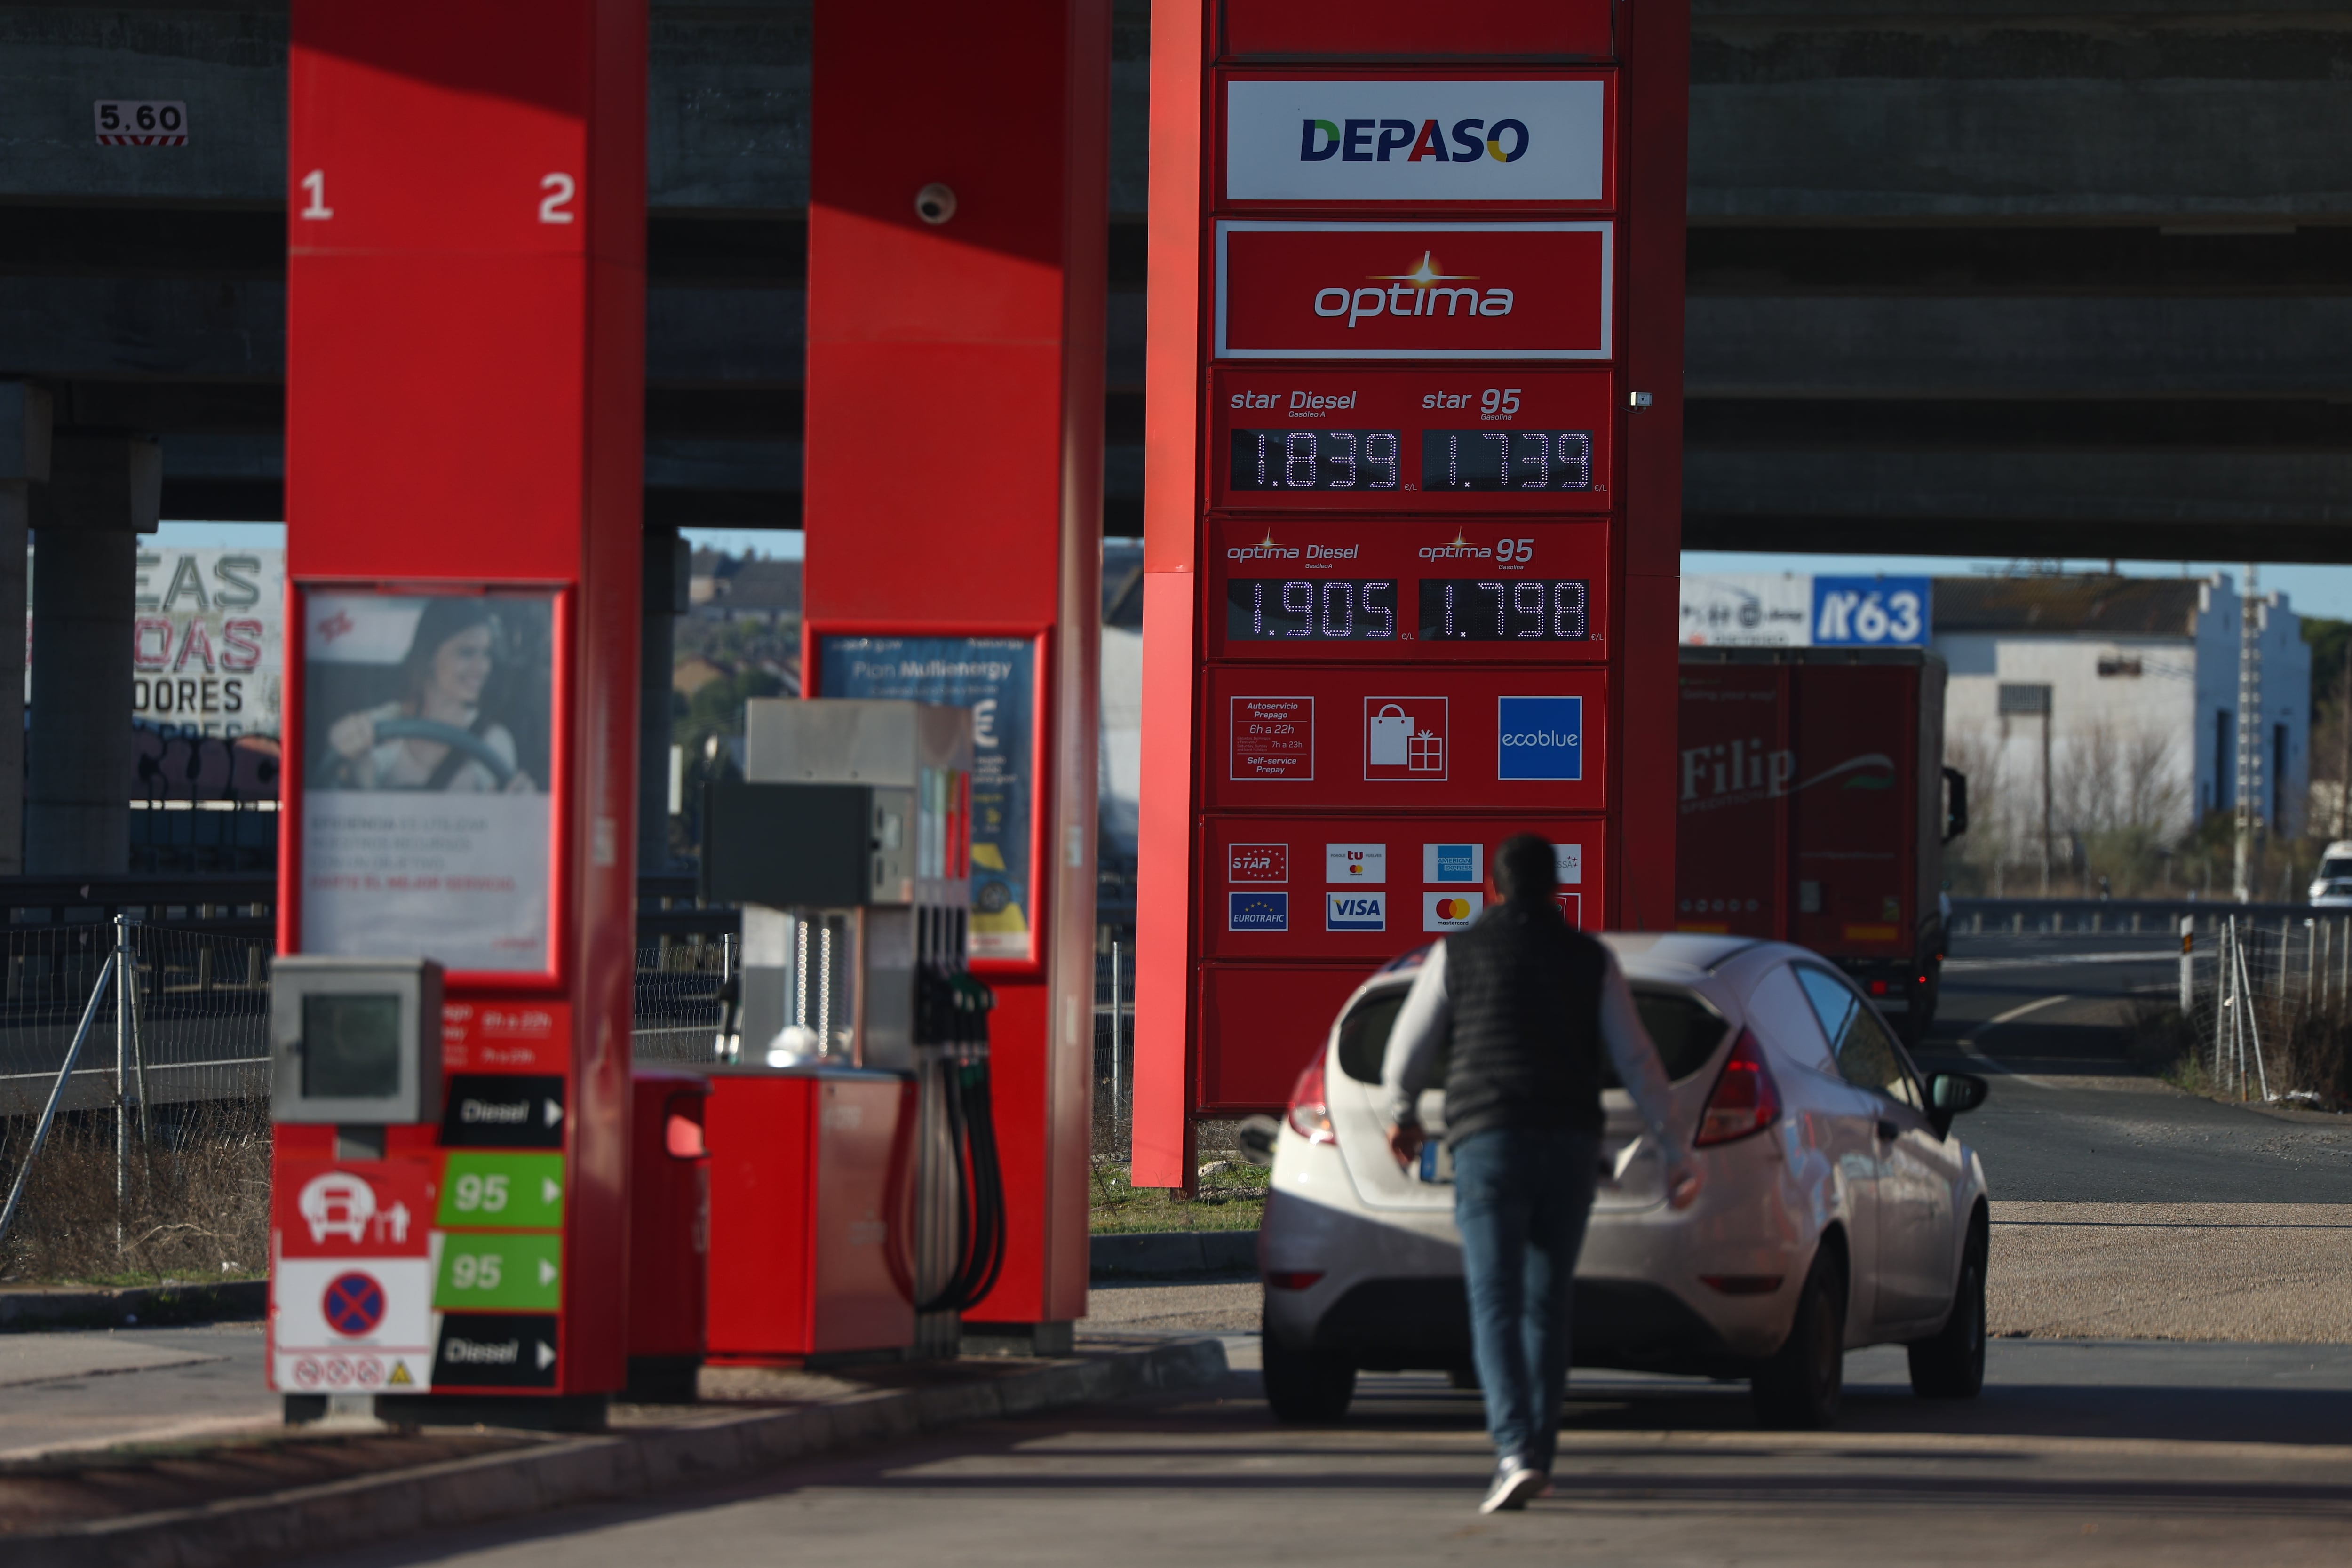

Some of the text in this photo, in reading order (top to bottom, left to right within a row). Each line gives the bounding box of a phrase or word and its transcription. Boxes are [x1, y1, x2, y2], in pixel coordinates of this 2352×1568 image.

[1300, 118, 1530, 163] DEPASO
[301, 168, 334, 220] 1
[538, 172, 575, 224] 2
[1314, 268, 1515, 328] optima
[1231, 390, 1357, 409] star Diesel
[1422, 388, 1522, 414] star 95
[1258, 432, 1397, 487] 1.839
[1450, 433, 1589, 487] 1.739
[1404, 483, 1417, 491] €/L
[1594, 483, 1607, 492] €/L
[1226, 542, 1359, 563] optima Diesel
[1418, 538, 1534, 563] optima 95
[1255, 581, 1393, 637] 1.905
[1446, 582, 1585, 637] 1.798
[852, 659, 1013, 681] Plan Multienergy
[1254, 711, 1287, 719] Prepago
[1249, 724, 1262, 734] 6h
[1274, 724, 1294, 734] 22h
[1502, 730, 1578, 747] ecoblue
[1256, 766, 1284, 774] Prepay
[1681, 735, 1797, 801] Filip
[1232, 857, 1271, 869] STAR
[1347, 850, 1363, 860] tu
[1332, 899, 1381, 916] VISA
[460, 1099, 530, 1123] Diesel
[455, 1173, 510, 1212] 95
[450, 1254, 504, 1290] 95
[444, 1338, 519, 1364] Diesel
